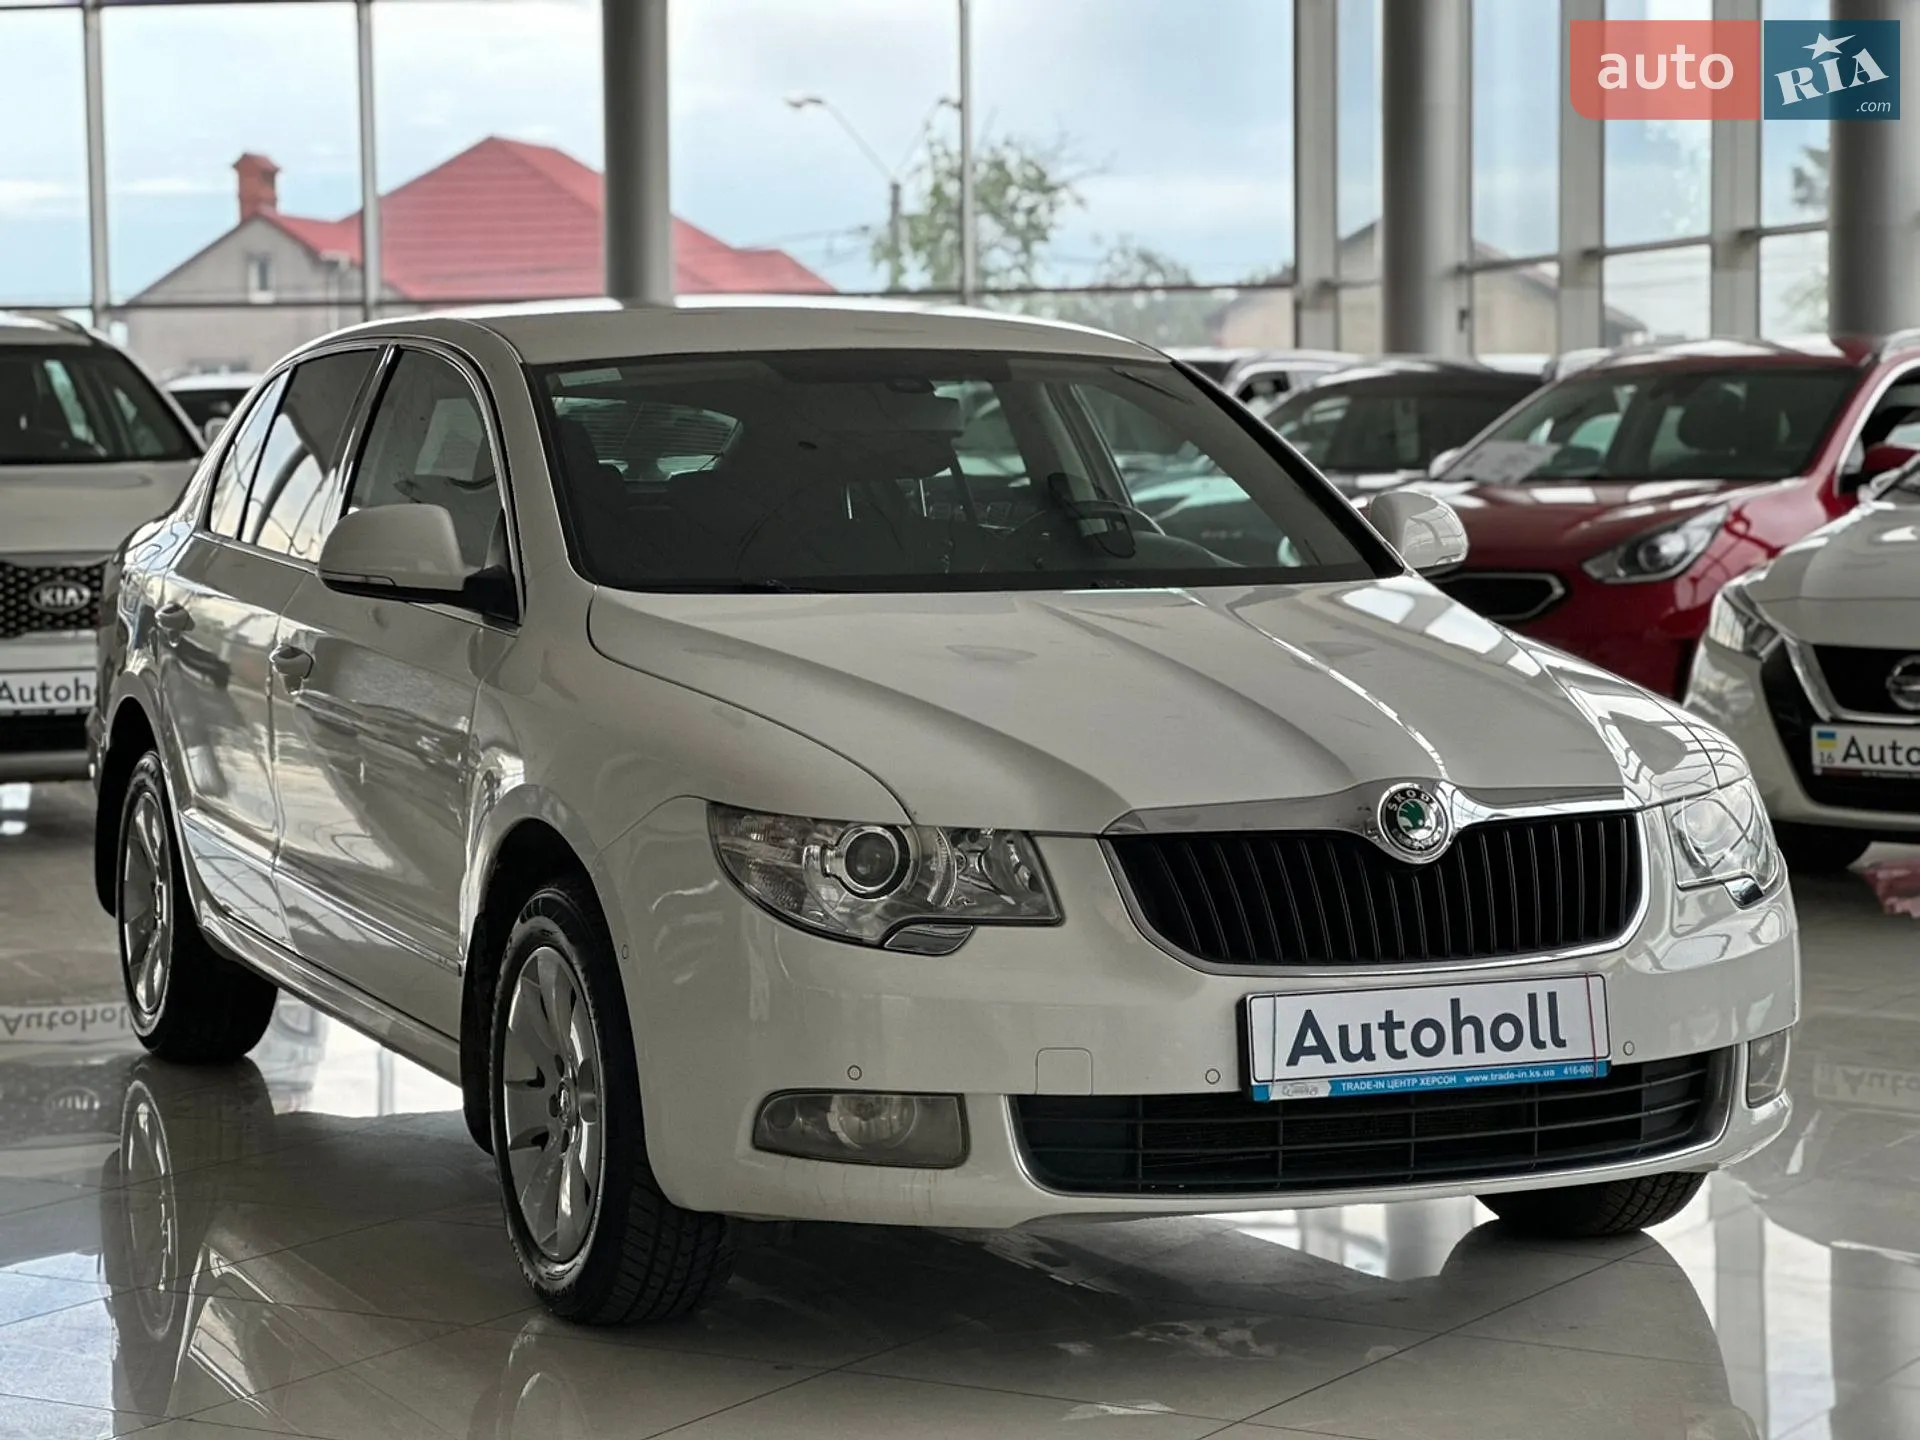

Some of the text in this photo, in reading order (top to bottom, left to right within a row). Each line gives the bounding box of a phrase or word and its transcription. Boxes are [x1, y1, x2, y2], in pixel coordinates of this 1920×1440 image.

[38, 587, 81, 607] KIA
[1819, 752, 1835, 764] 16
[1285, 991, 1567, 1067] Autoholl
